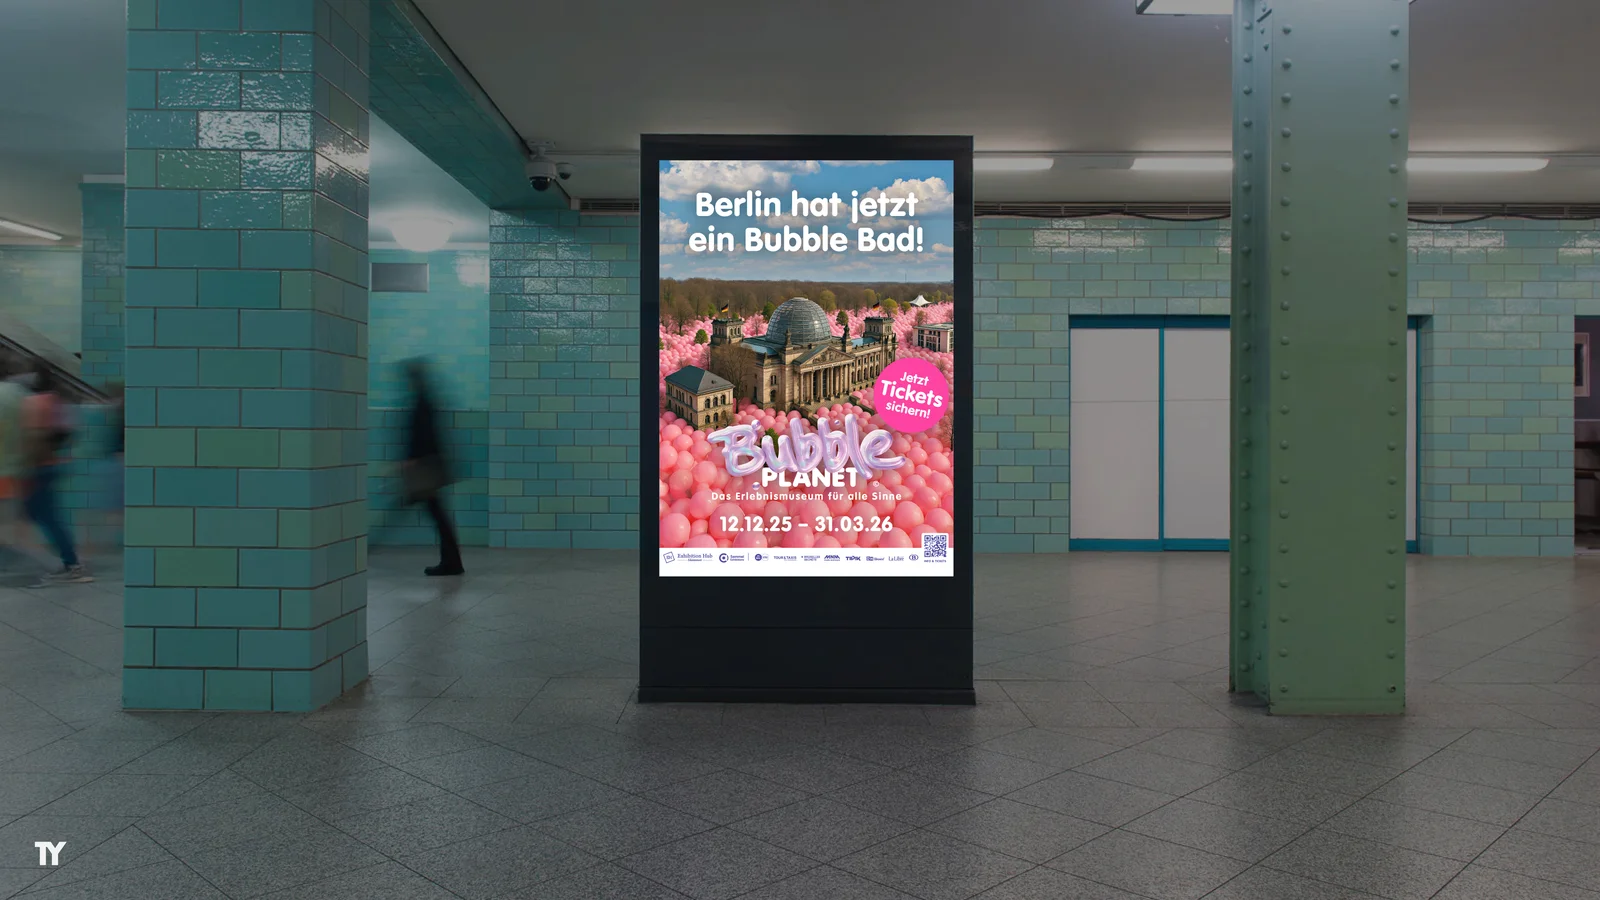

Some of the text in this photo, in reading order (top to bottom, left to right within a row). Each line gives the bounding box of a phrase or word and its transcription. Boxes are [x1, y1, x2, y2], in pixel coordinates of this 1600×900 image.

[695, 190, 919, 224] Berlin hat jetzt
[688, 225, 924, 252] ein Bubble Bad!
[900, 372, 929, 386] Jetzt
[881, 379, 943, 408] Tickets
[885, 400, 931, 419] sichern!
[707, 413, 906, 479] Bubble
[761, 467, 859, 487] PLANET
[711, 491, 902, 501] Das Erlebnismuseum für alle Sinne
[720, 516, 792, 532] 12.12.25
[814, 516, 893, 532] 31.03.26
